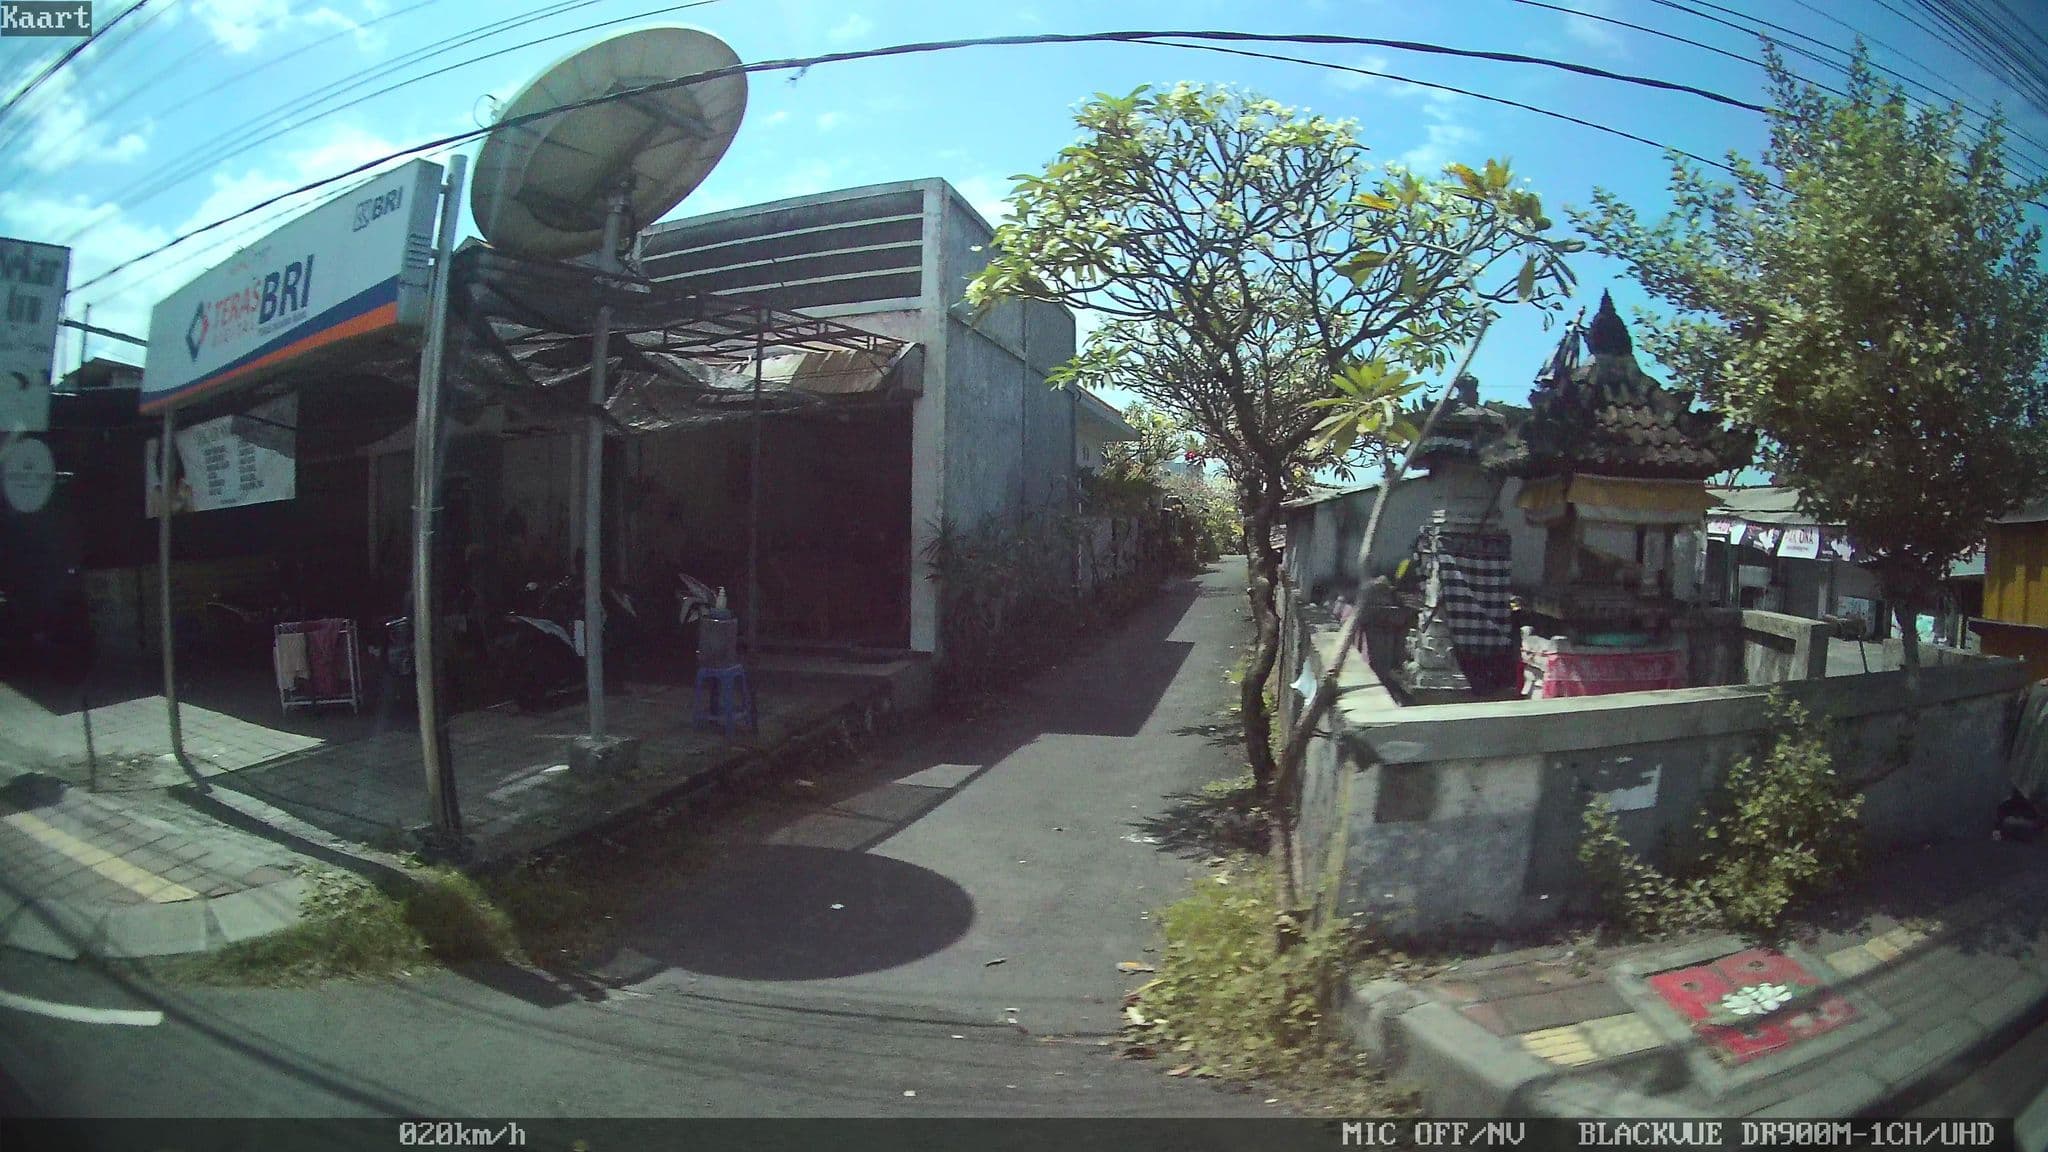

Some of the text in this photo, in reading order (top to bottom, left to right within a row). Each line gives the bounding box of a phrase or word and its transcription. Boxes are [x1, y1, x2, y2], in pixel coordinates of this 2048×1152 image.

[372, 186, 403, 220] BRI
[214, 279, 260, 326] TERAS
[258, 253, 314, 324] BRI
